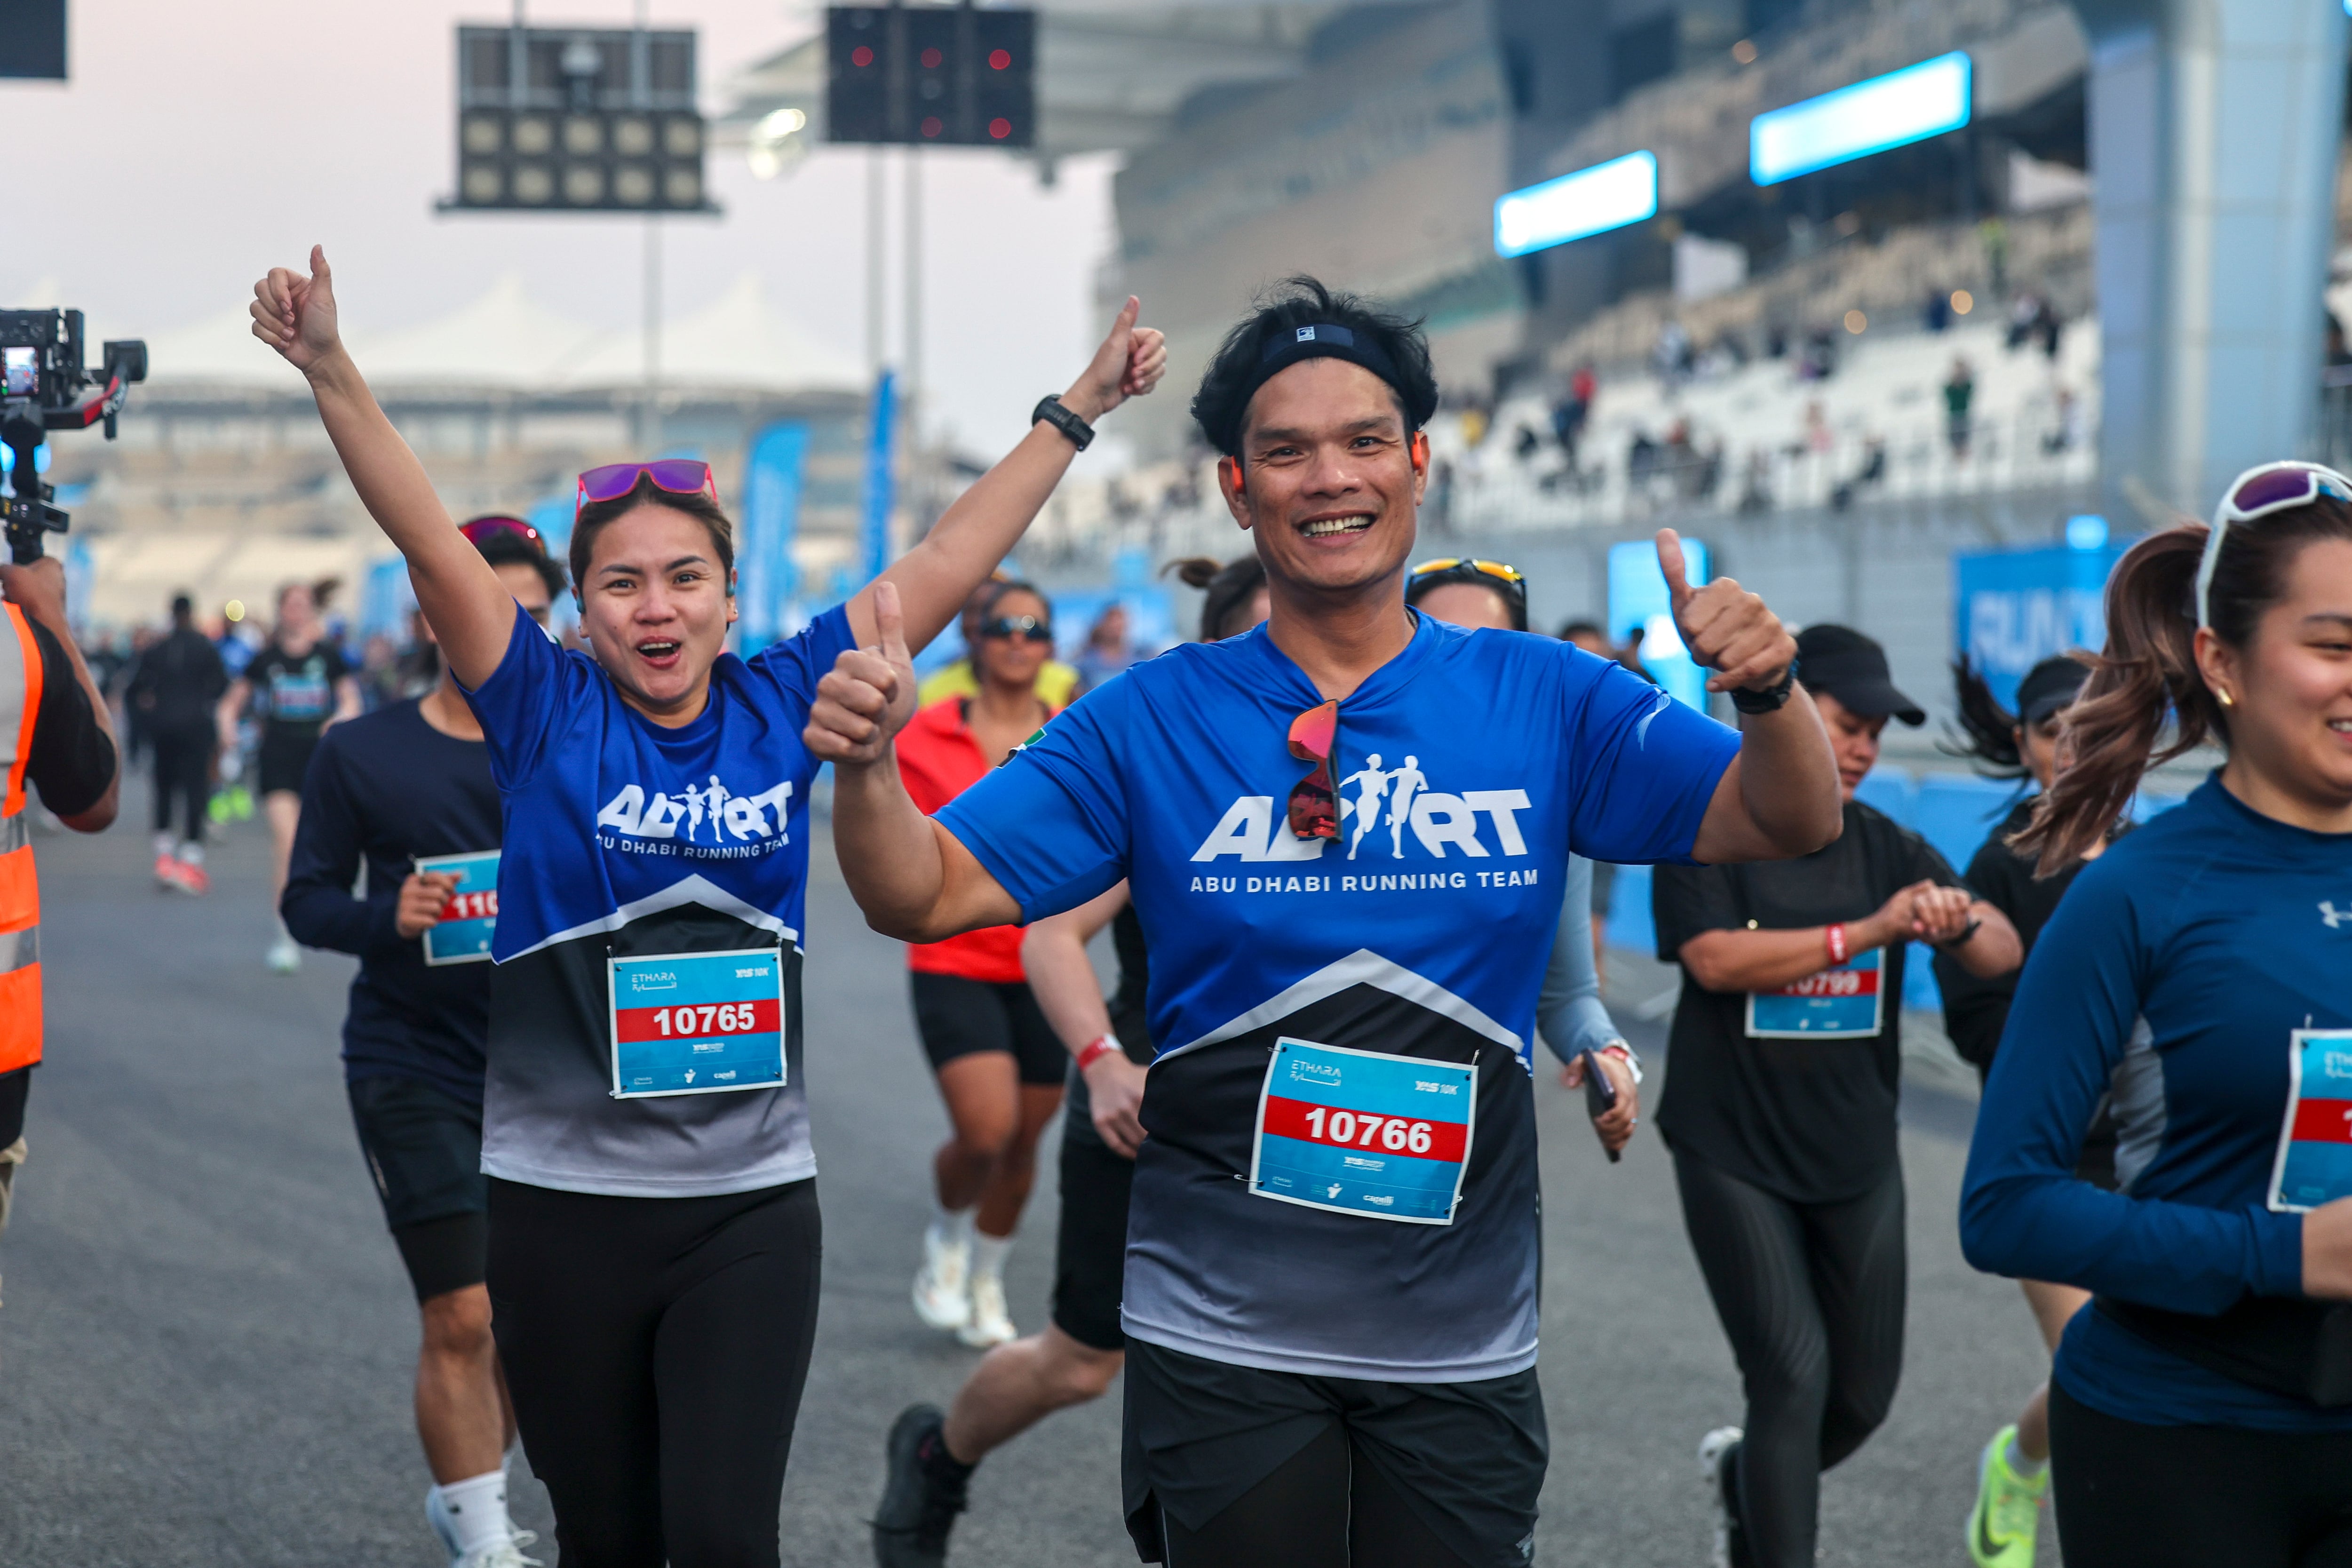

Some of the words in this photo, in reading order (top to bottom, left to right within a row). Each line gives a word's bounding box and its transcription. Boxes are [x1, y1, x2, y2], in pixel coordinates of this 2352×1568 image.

[621, 839, 677, 856] DHABI
[683, 844, 760, 860] RUNNING
[1190, 876, 1236, 893] ABU
[1246, 876, 1331, 893] DHABI
[1341, 872, 1466, 892] RUNNING
[1476, 868, 1538, 888] TEAM
[631, 971, 676, 983] ETHARA
[1786, 971, 1861, 996] 0799
[653, 1003, 755, 1036] 10765
[1291, 1059, 1342, 1077] ETHARA
[1305, 1107, 1433, 1154] 10766
